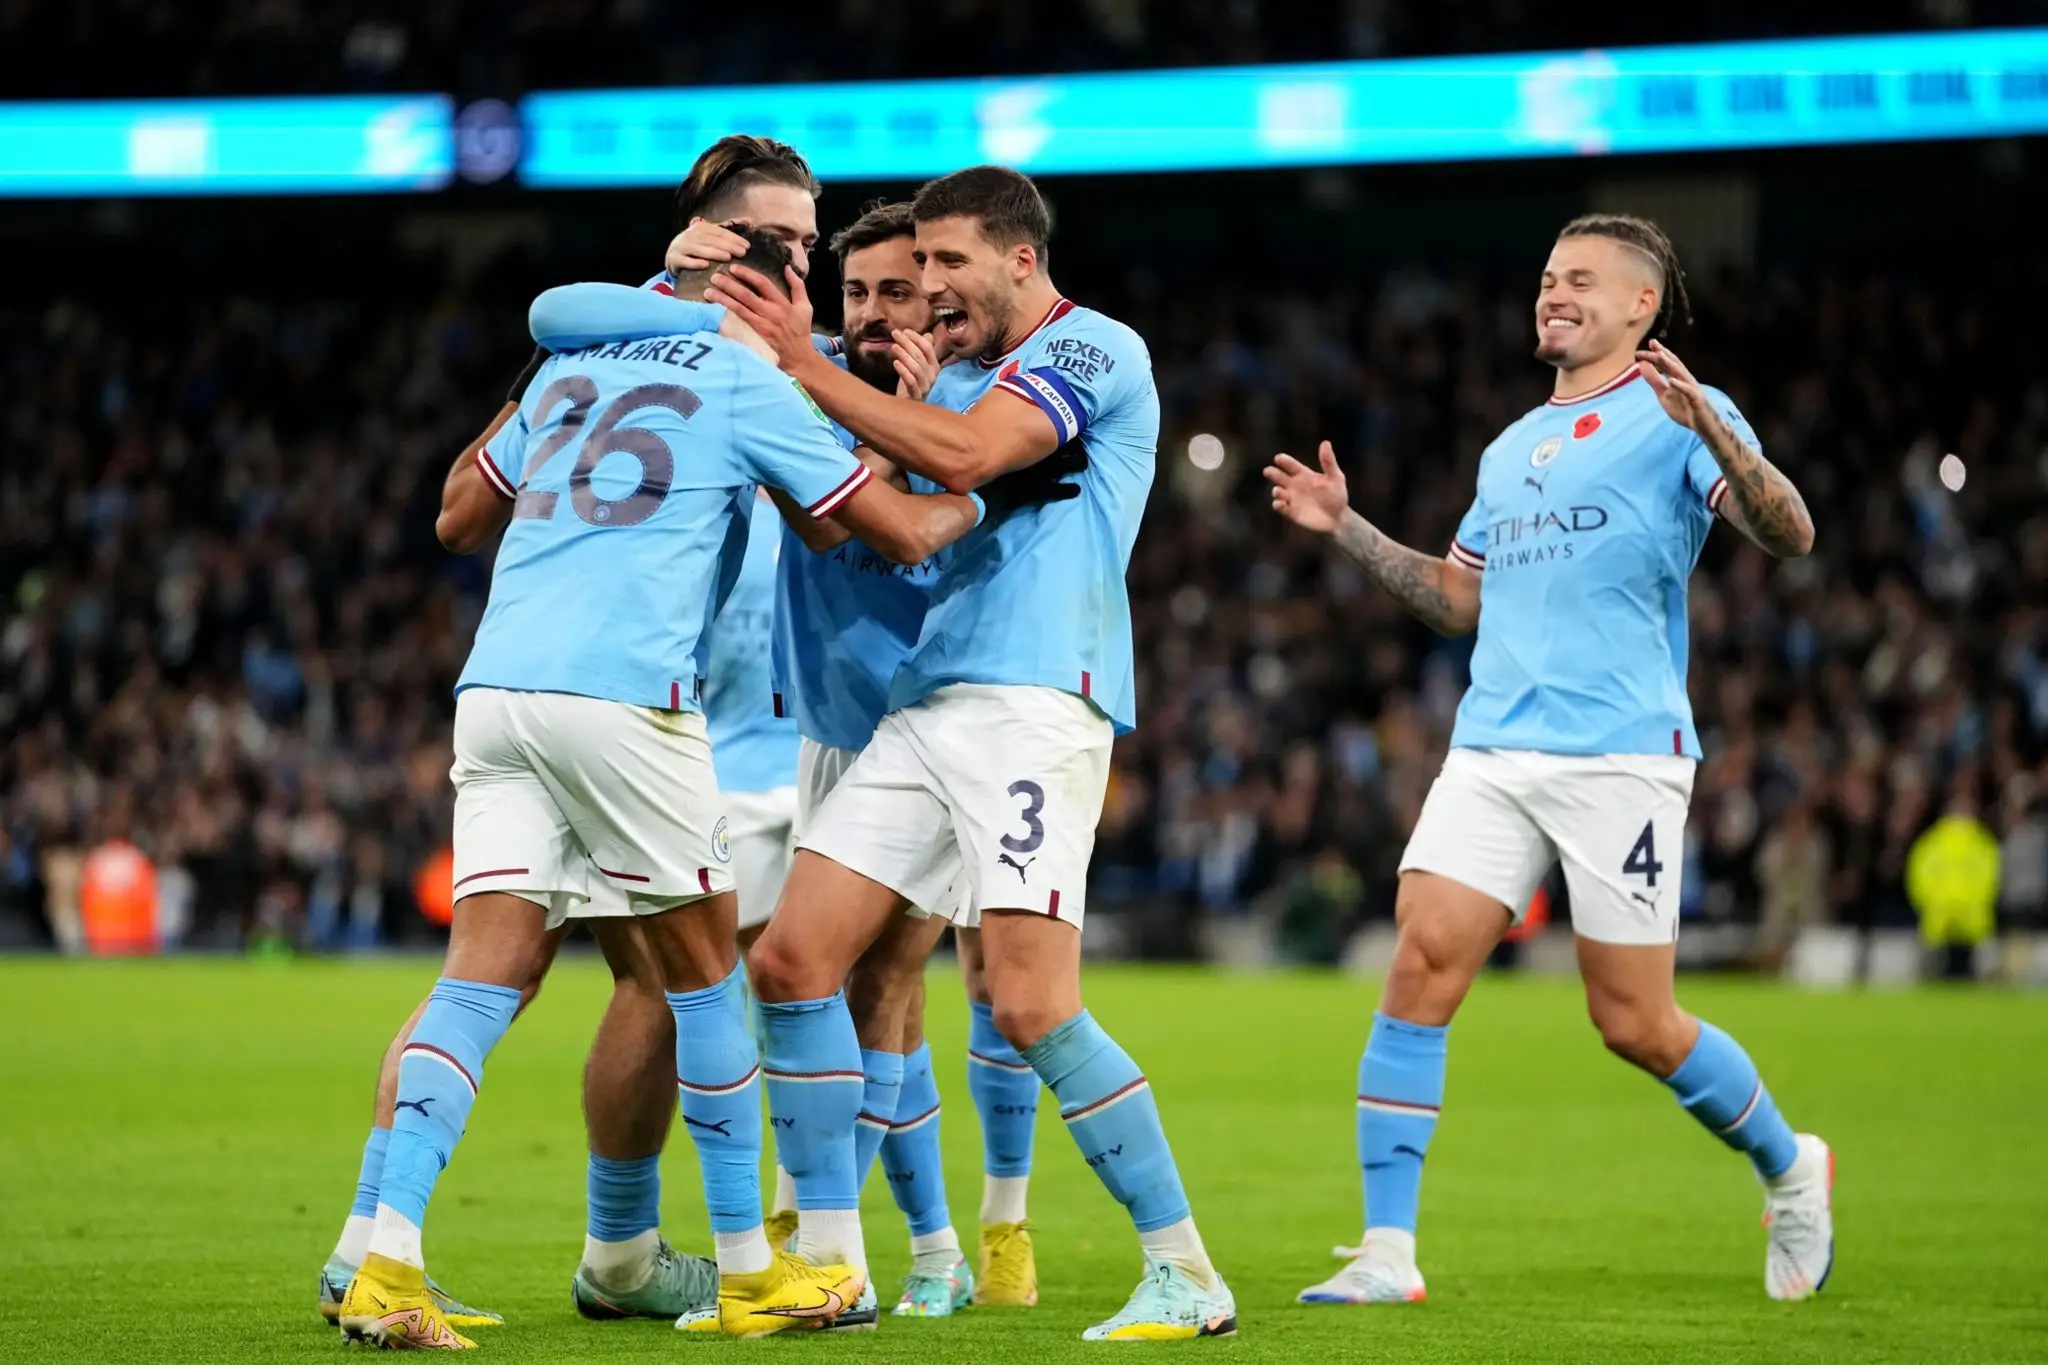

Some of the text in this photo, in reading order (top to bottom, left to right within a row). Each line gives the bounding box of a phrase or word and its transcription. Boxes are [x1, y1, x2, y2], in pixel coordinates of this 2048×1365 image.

[1045, 338, 1116, 374] NEXEN
[1052, 353, 1099, 383] TIRE
[1041, 385, 1075, 425] CAPTAIN
[513, 374, 704, 527] 26
[1488, 542, 1574, 573] AIRWAYS
[1000, 779, 1045, 853] 3
[1622, 818, 1663, 887] 4
